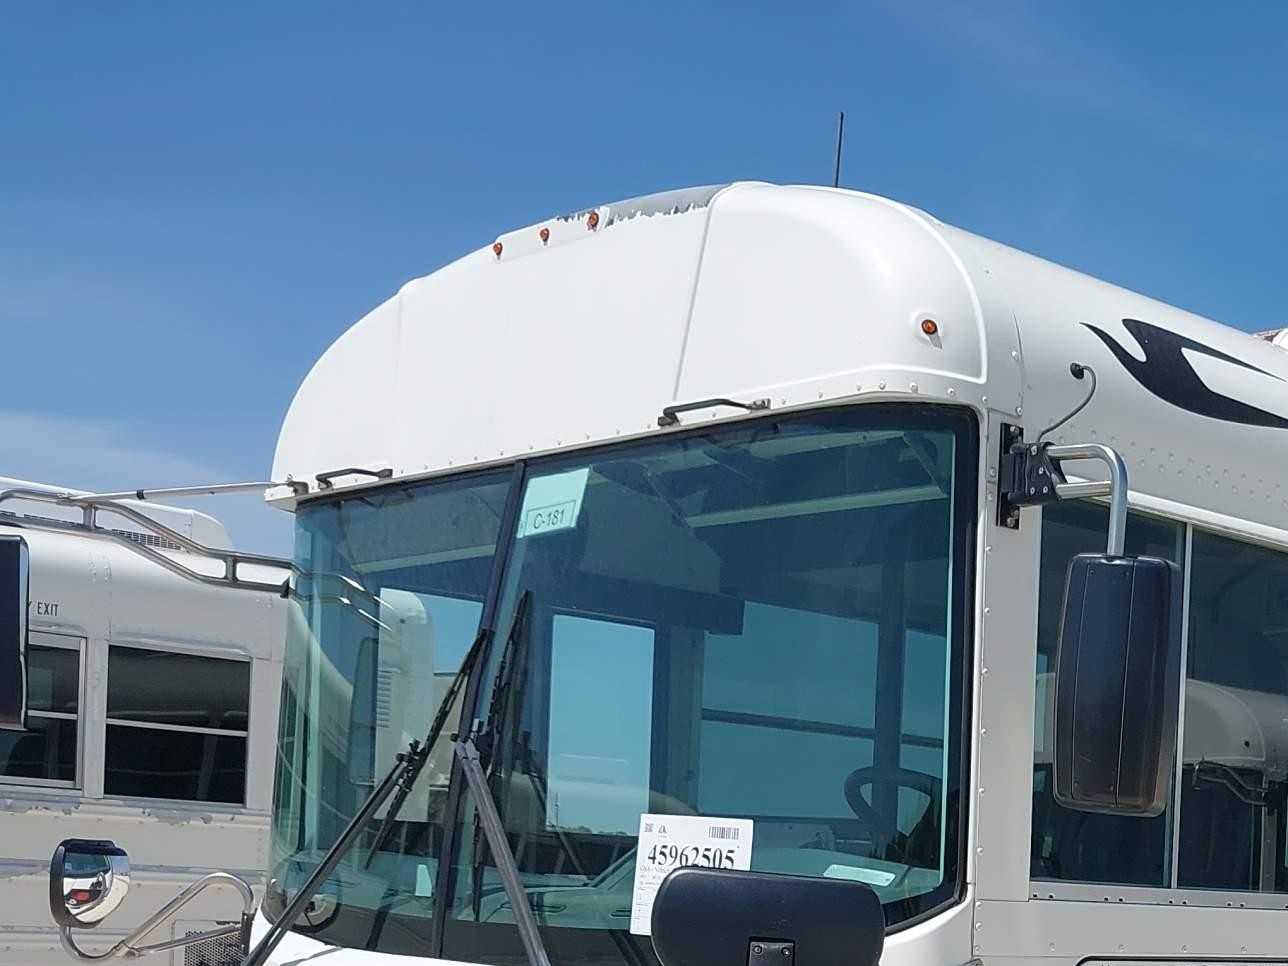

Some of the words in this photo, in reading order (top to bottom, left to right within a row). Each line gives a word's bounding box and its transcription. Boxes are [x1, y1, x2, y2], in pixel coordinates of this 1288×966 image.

[533, 507, 566, 529] C-181
[37, 601, 59, 617] EXIT
[647, 844, 736, 869] 45962505
